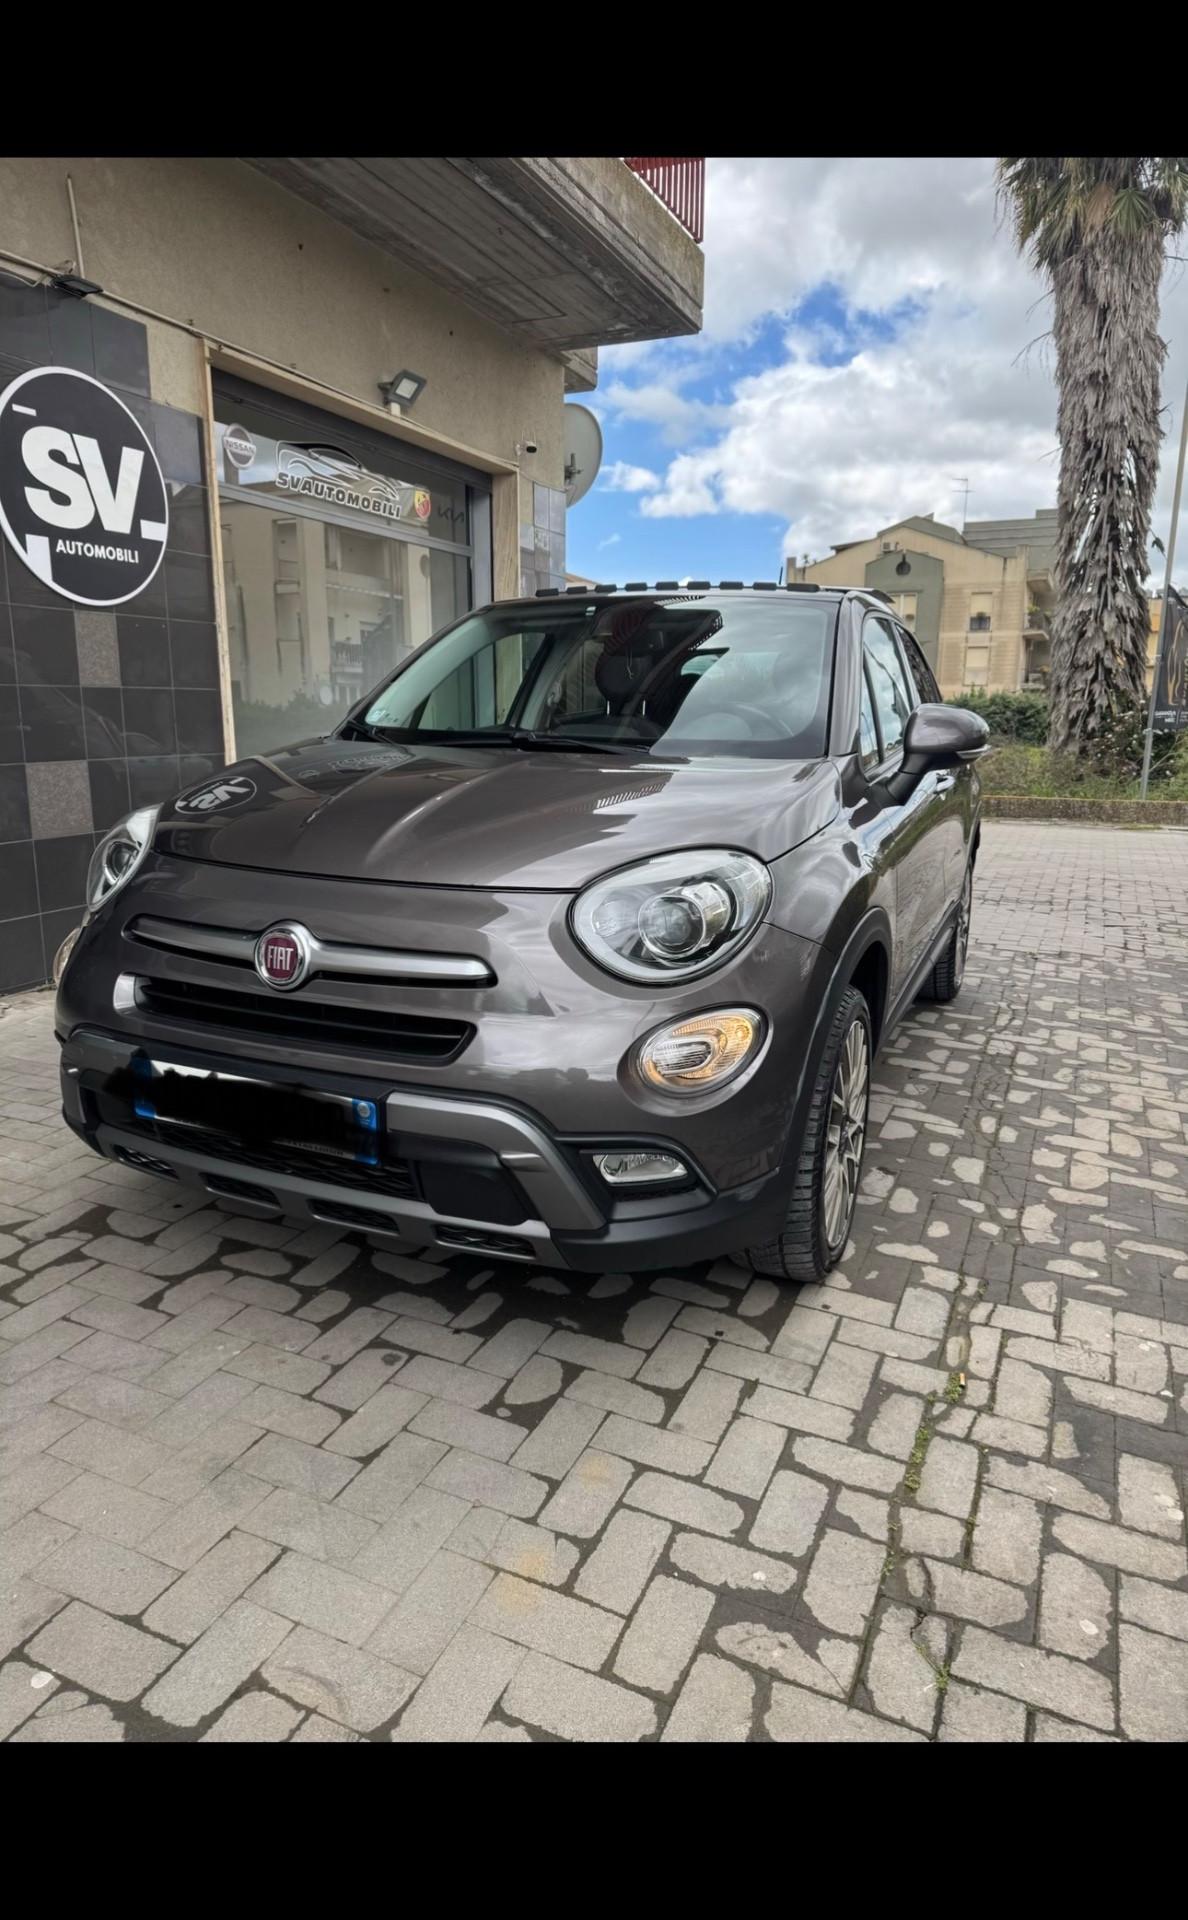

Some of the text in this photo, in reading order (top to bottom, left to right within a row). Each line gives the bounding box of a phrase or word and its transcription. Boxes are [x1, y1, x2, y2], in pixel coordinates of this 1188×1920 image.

[224, 438, 256, 456] NISSAN
[22, 426, 145, 534] SV
[276, 471, 402, 519] SVAUTOMOBILI
[56, 539, 139, 564] AUTOMOBILI
[267, 945, 294, 970] FIAT
